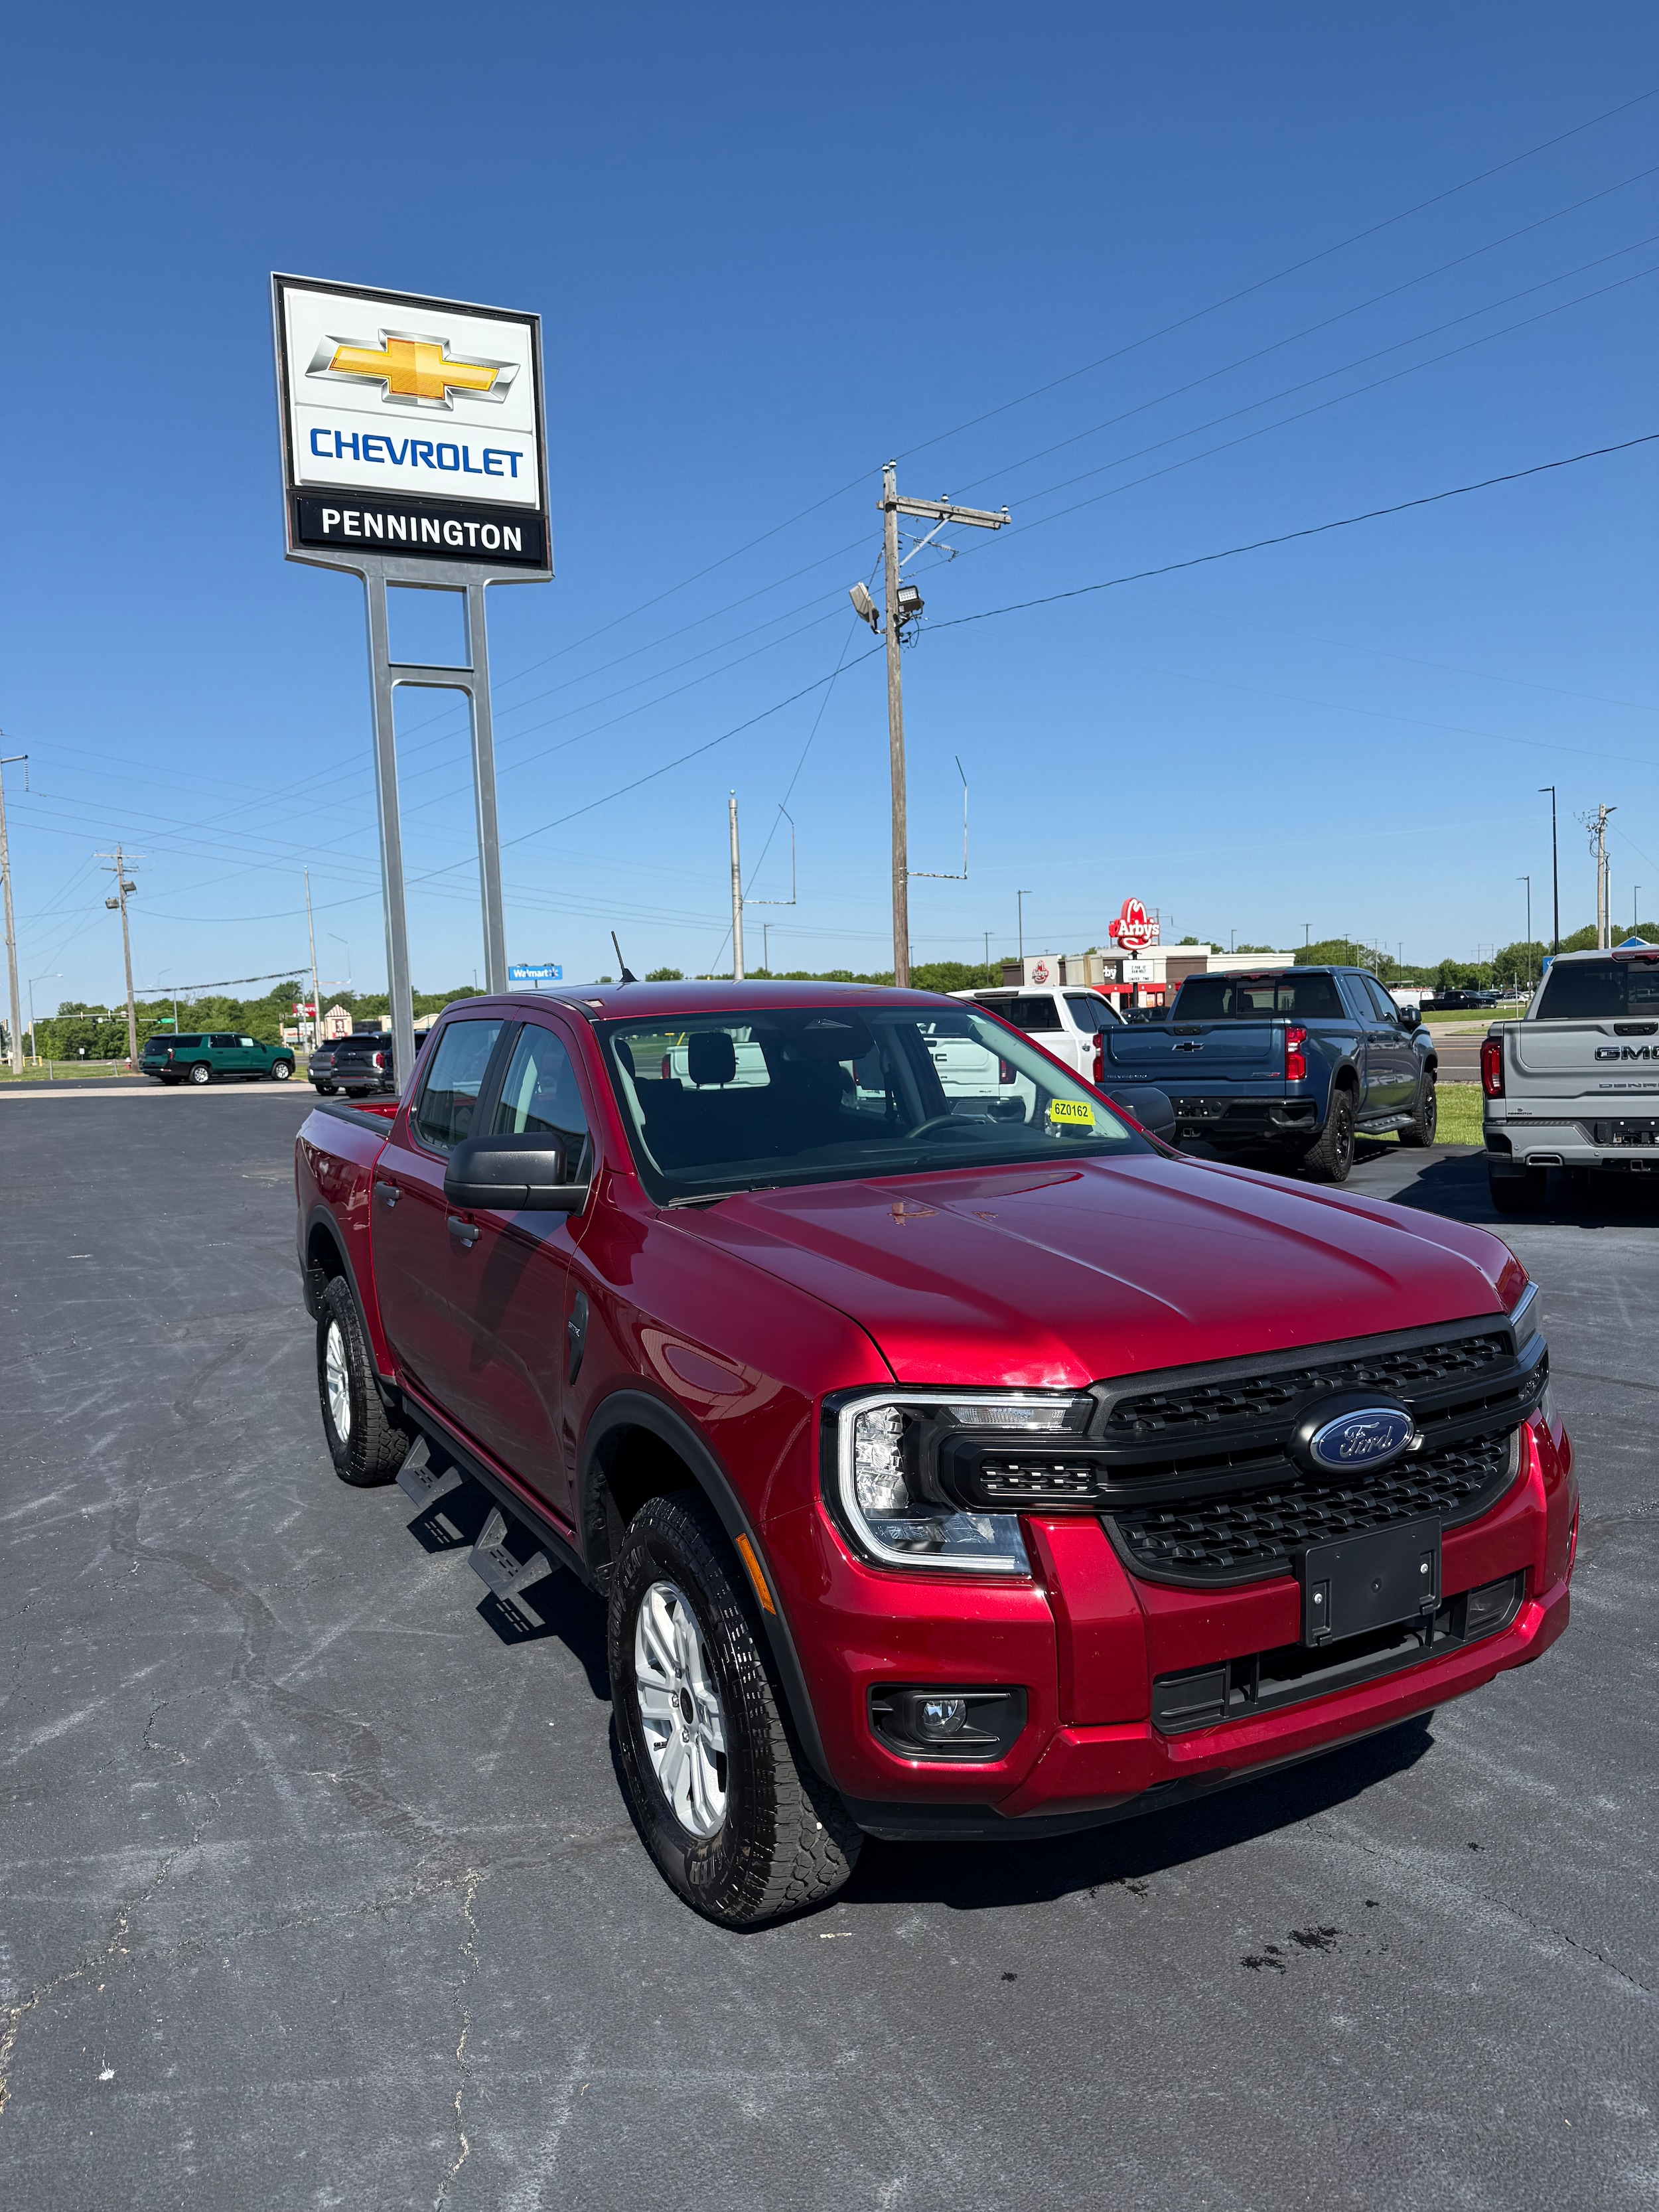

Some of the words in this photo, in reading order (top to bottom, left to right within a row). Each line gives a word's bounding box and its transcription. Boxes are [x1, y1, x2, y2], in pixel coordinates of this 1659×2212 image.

[310, 428, 524, 478] CHEVROLET
[322, 508, 523, 552] PENNINGTON
[1118, 919, 1159, 940] Arby's
[513, 968, 549, 978] Walmart
[1055, 1103, 1088, 1117] 6Z0162
[1339, 1421, 1394, 1458] Ford
